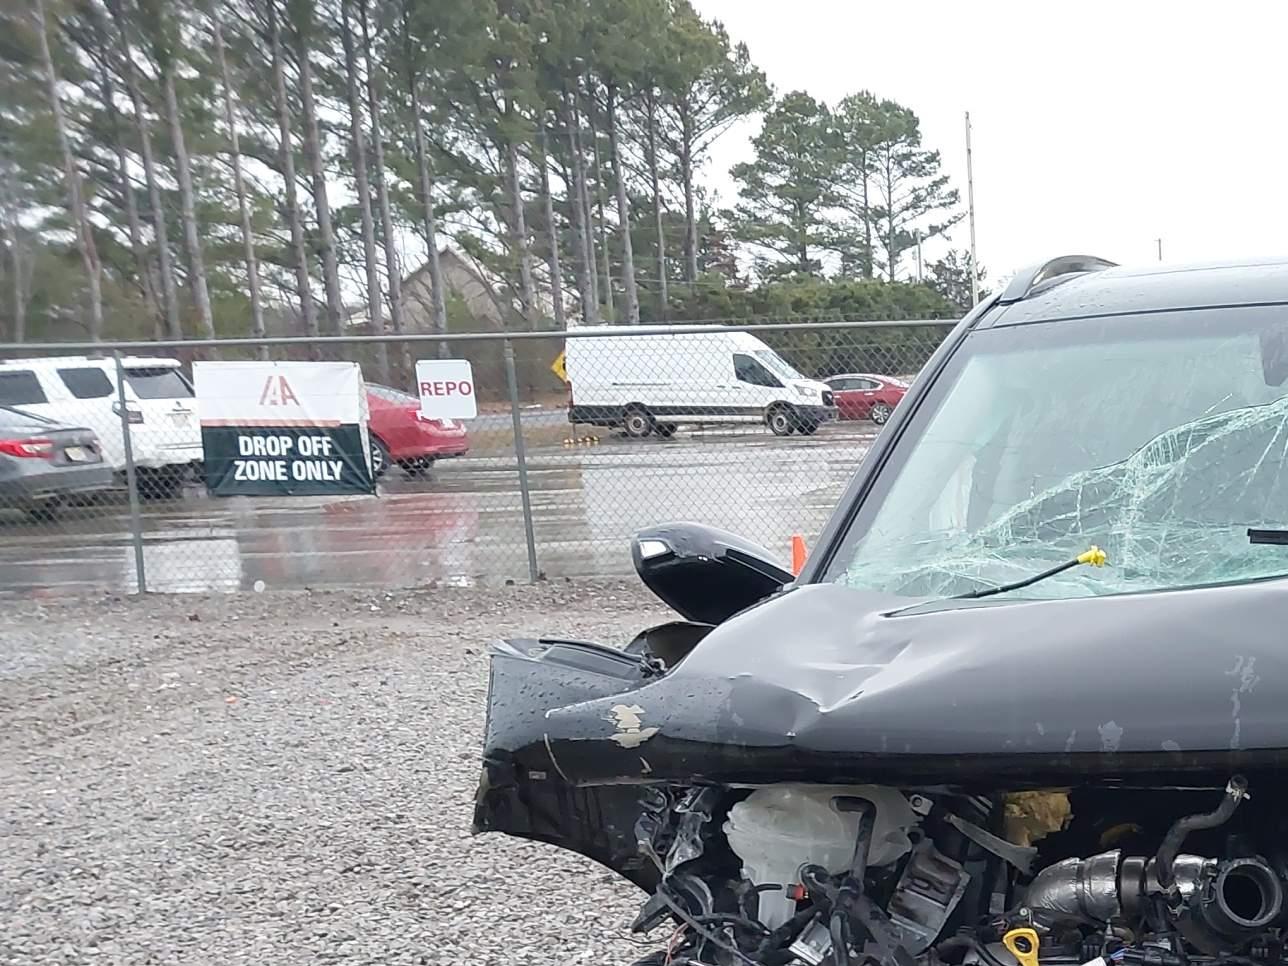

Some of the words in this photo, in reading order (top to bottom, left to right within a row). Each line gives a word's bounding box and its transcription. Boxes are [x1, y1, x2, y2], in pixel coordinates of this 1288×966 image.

[420, 381, 472, 396] REPO
[238, 435, 296, 457] DROP
[298, 434, 333, 457] OFF
[233, 460, 290, 481] ZONE
[292, 459, 343, 481] ONLY
